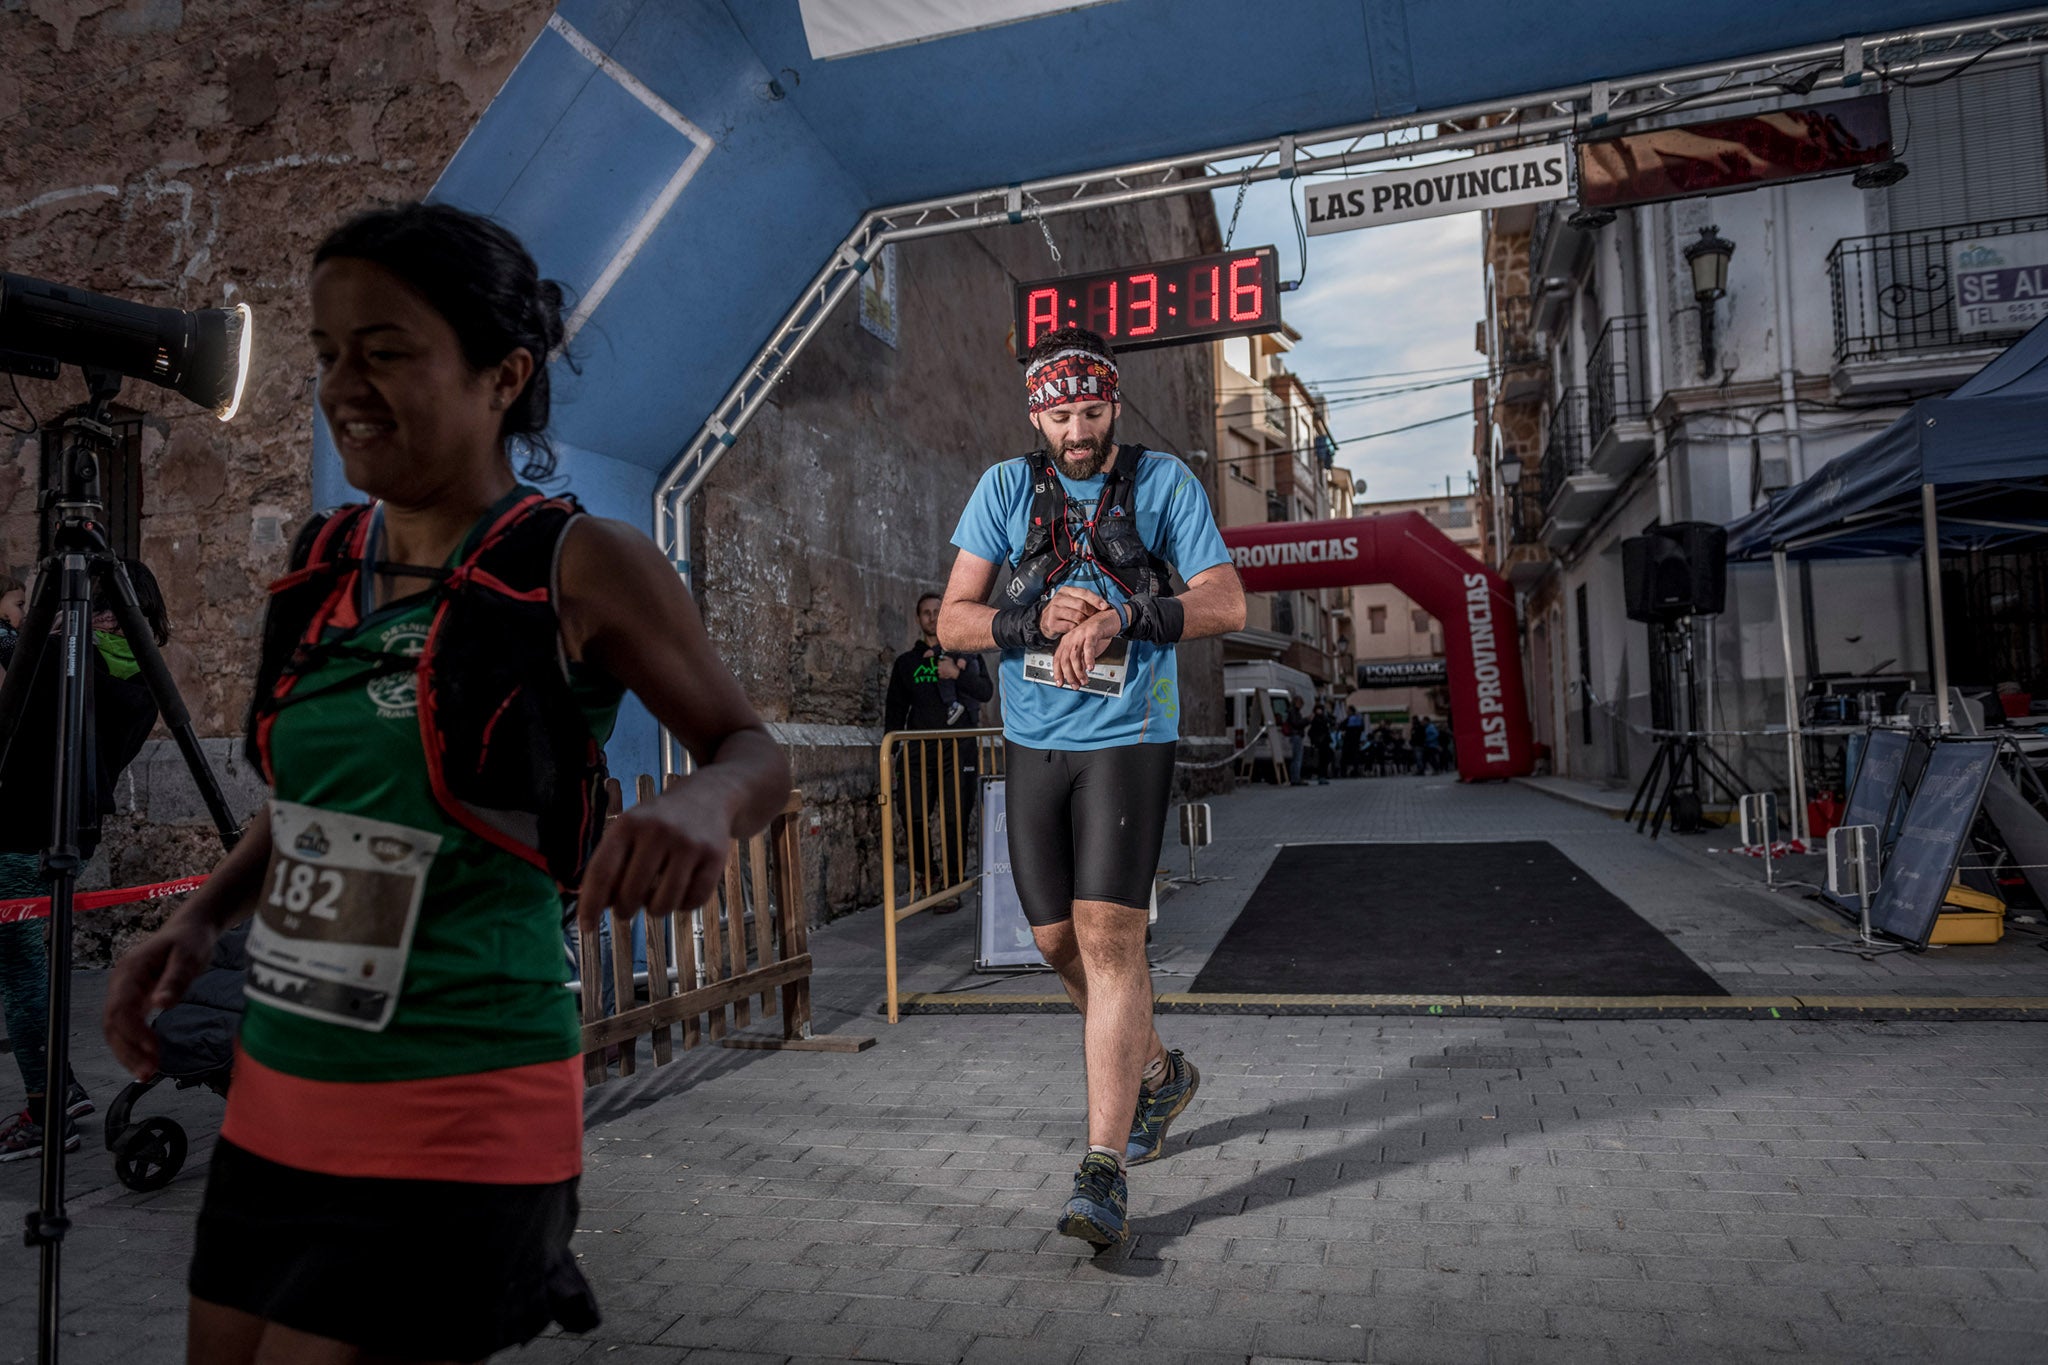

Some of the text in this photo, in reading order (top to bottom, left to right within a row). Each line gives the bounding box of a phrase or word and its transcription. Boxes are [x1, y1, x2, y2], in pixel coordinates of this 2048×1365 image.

[1309, 157, 1563, 223] LAS PROVINCIAS
[1963, 274, 2000, 303] SE
[1366, 662, 1445, 677] POWERADE
[1463, 573, 1510, 763] LAS PROVINCIAS
[268, 859, 345, 921] 182
